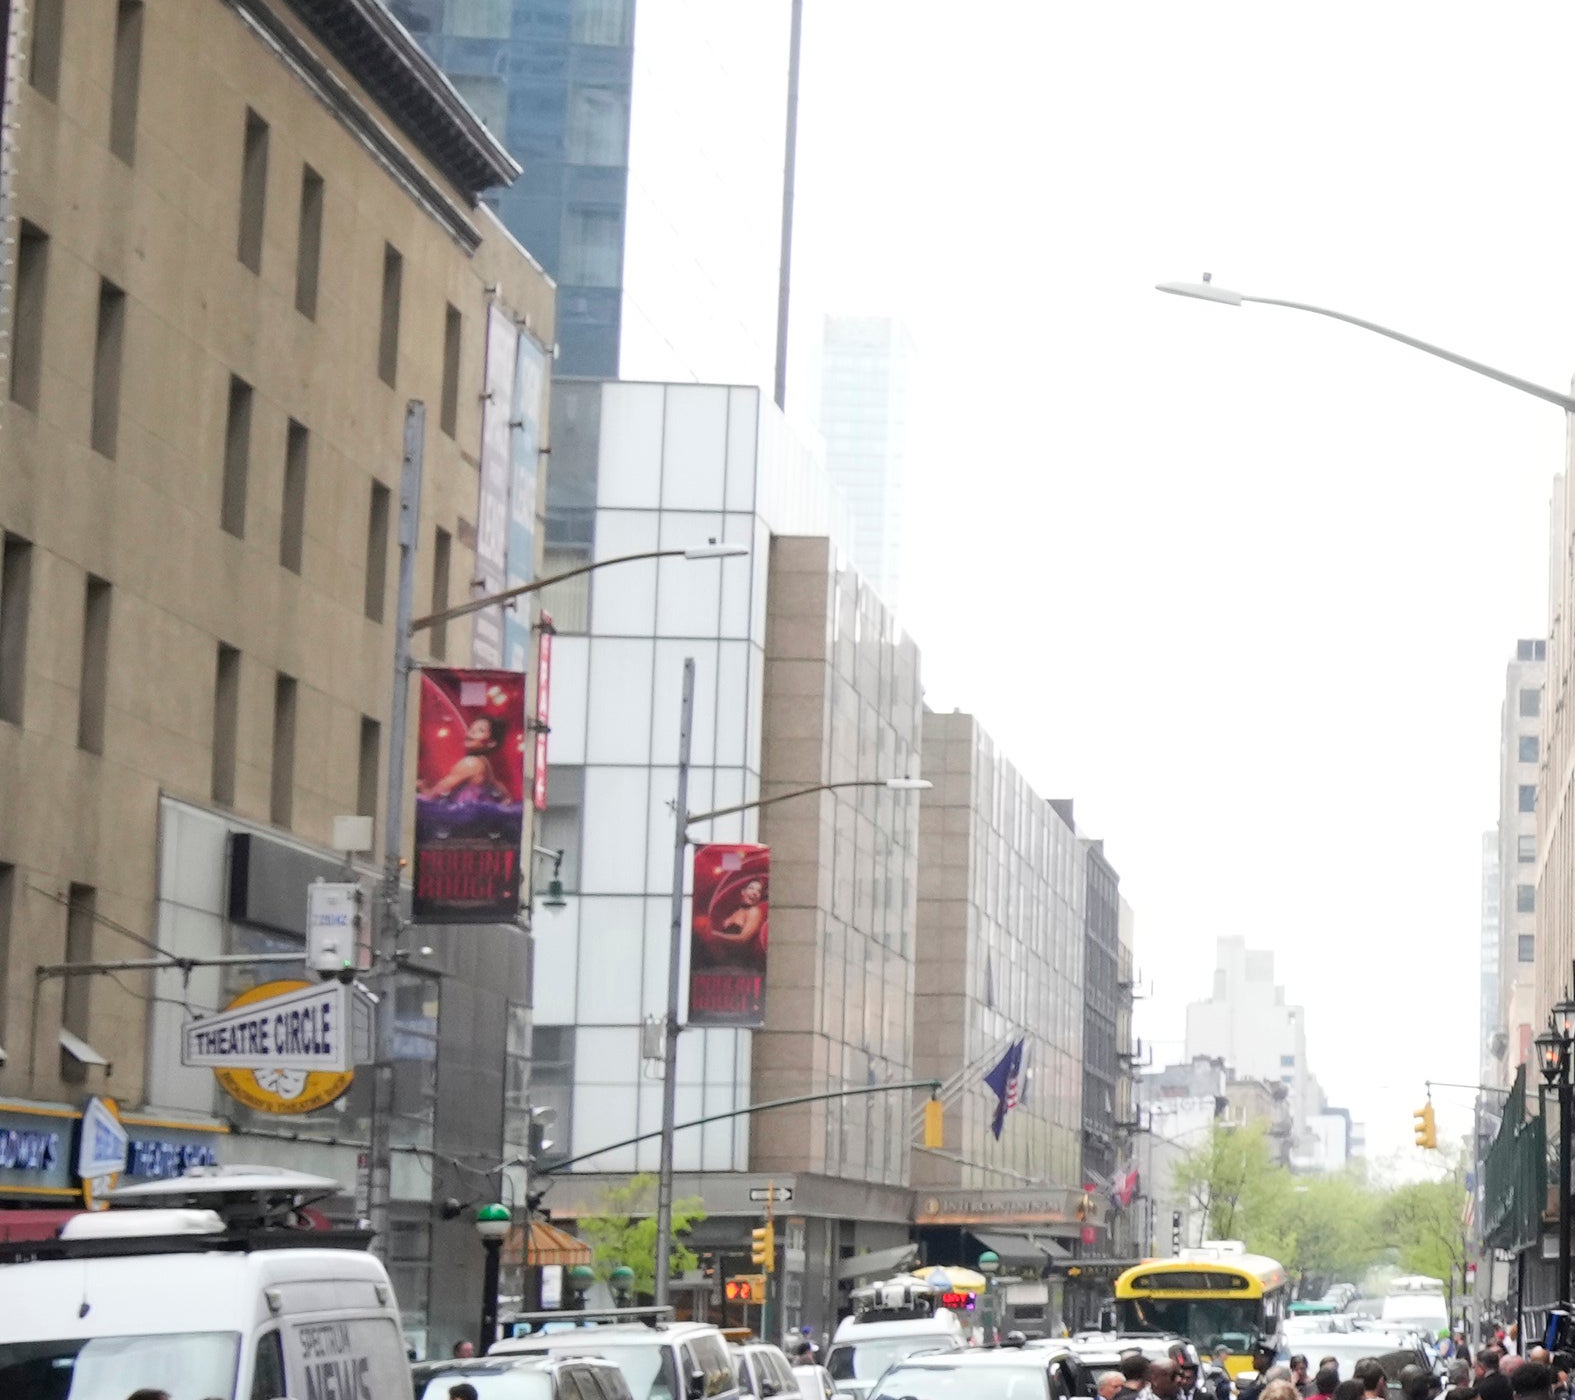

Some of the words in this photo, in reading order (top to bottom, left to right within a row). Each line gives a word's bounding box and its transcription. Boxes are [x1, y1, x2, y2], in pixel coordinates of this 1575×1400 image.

[195, 1017, 269, 1055] THEATRE
[274, 1003, 330, 1054] CIRCLE
[300, 1323, 351, 1358] SPECTRUM
